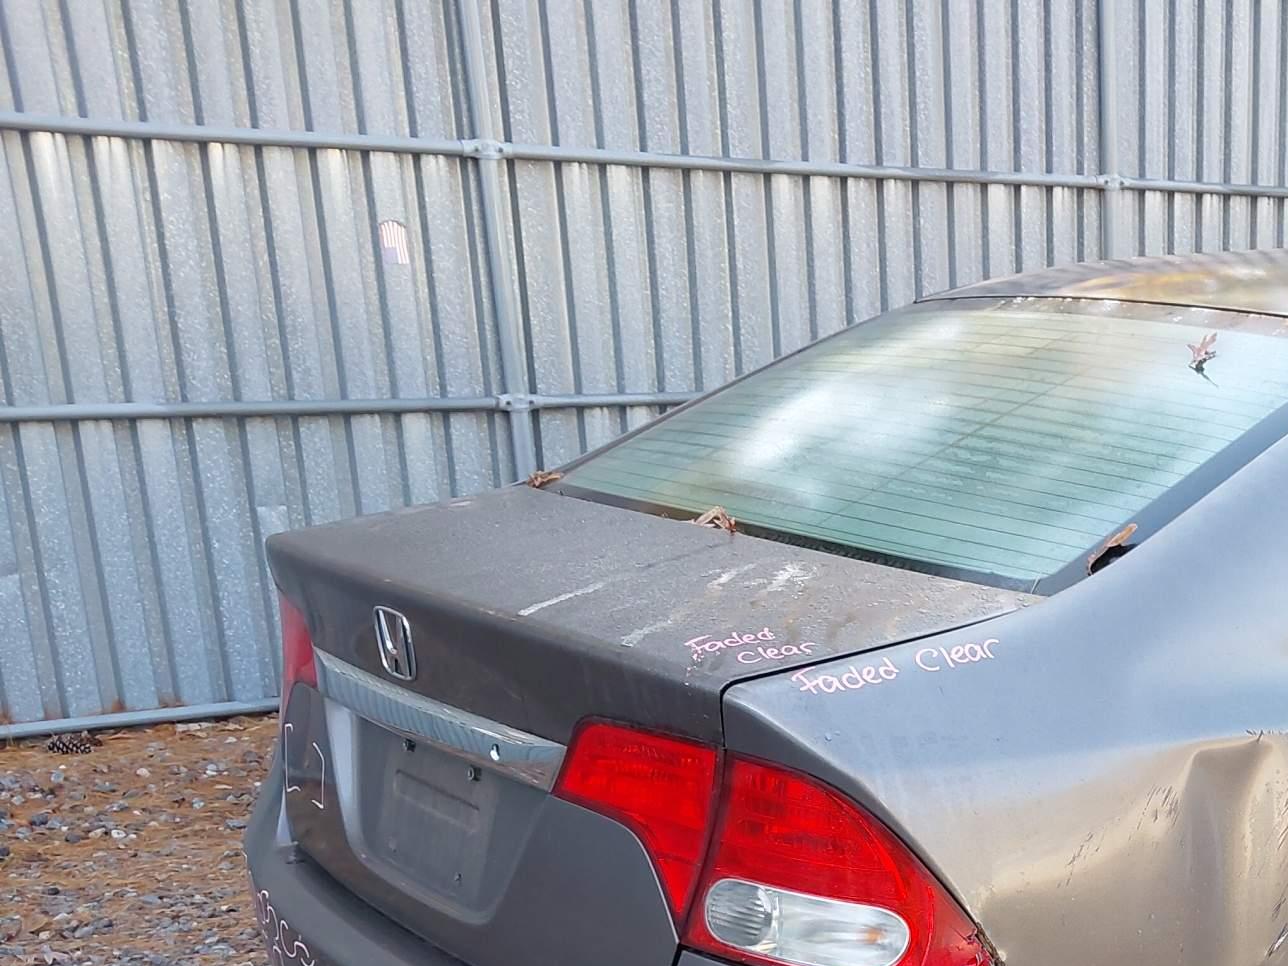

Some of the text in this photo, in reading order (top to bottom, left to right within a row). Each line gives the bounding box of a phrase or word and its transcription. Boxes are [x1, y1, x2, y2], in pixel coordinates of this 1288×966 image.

[684, 627, 776, 653] Faded
[736, 641, 817, 666] Clear
[791, 638, 999, 695] Faded Clear
